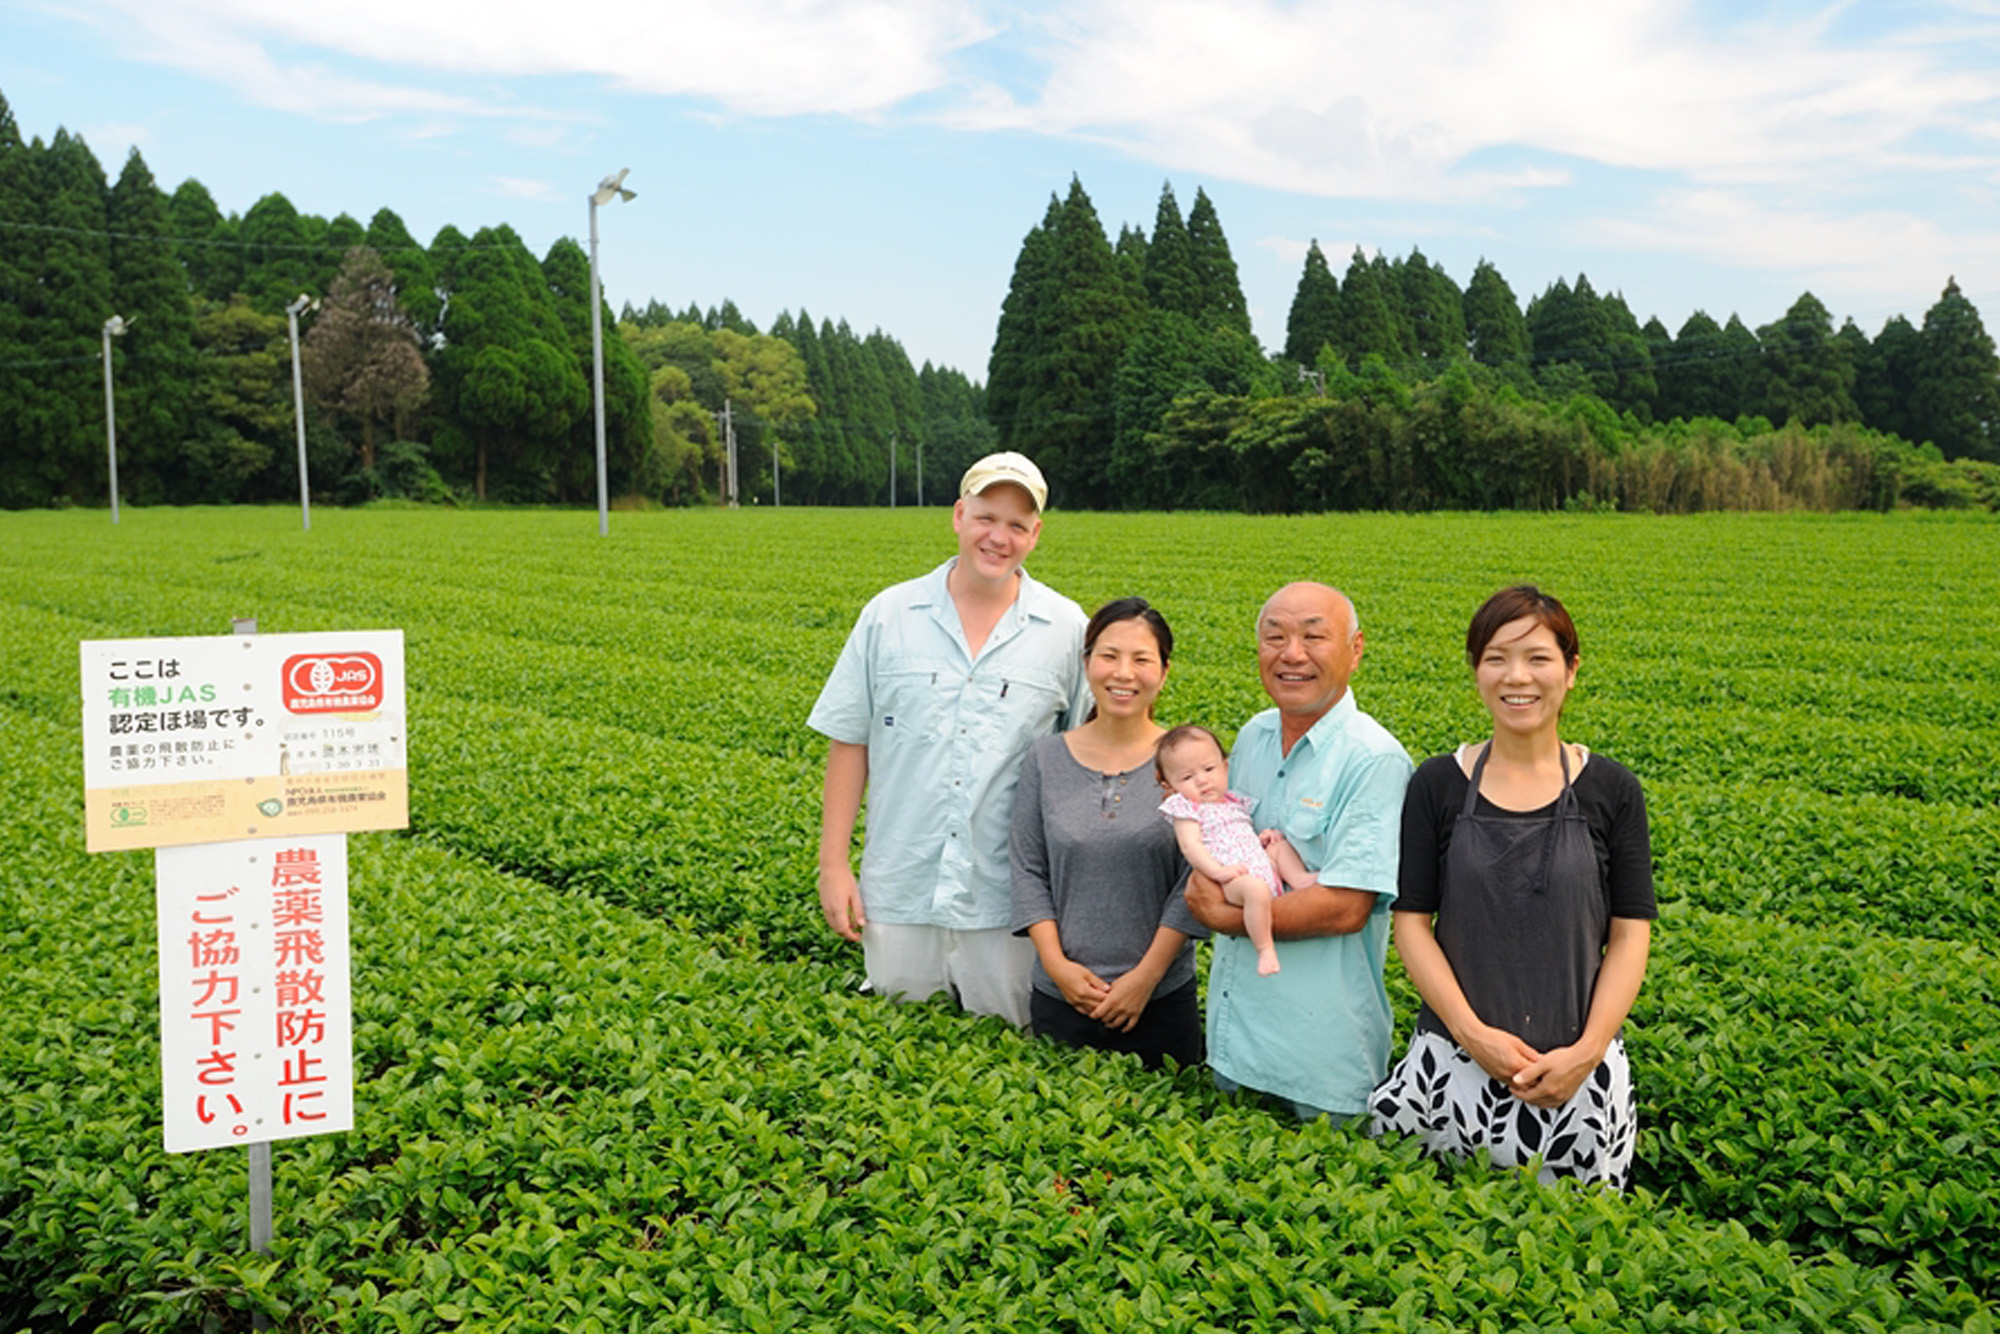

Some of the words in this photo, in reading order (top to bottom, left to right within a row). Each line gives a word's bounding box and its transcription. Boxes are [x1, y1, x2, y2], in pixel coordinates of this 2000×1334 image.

[109, 658, 181, 680] ここは
[336, 669, 368, 682] JAS
[108, 683, 217, 708] 有機JAS
[109, 706, 265, 734] 認定ほ場です。
[109, 738, 236, 758] 農薬の飛散防止に
[110, 755, 214, 771] ご協力下さい。
[271, 847, 328, 1125] 農薬飛散防止に
[187, 884, 249, 1137] ご協力下さい。
